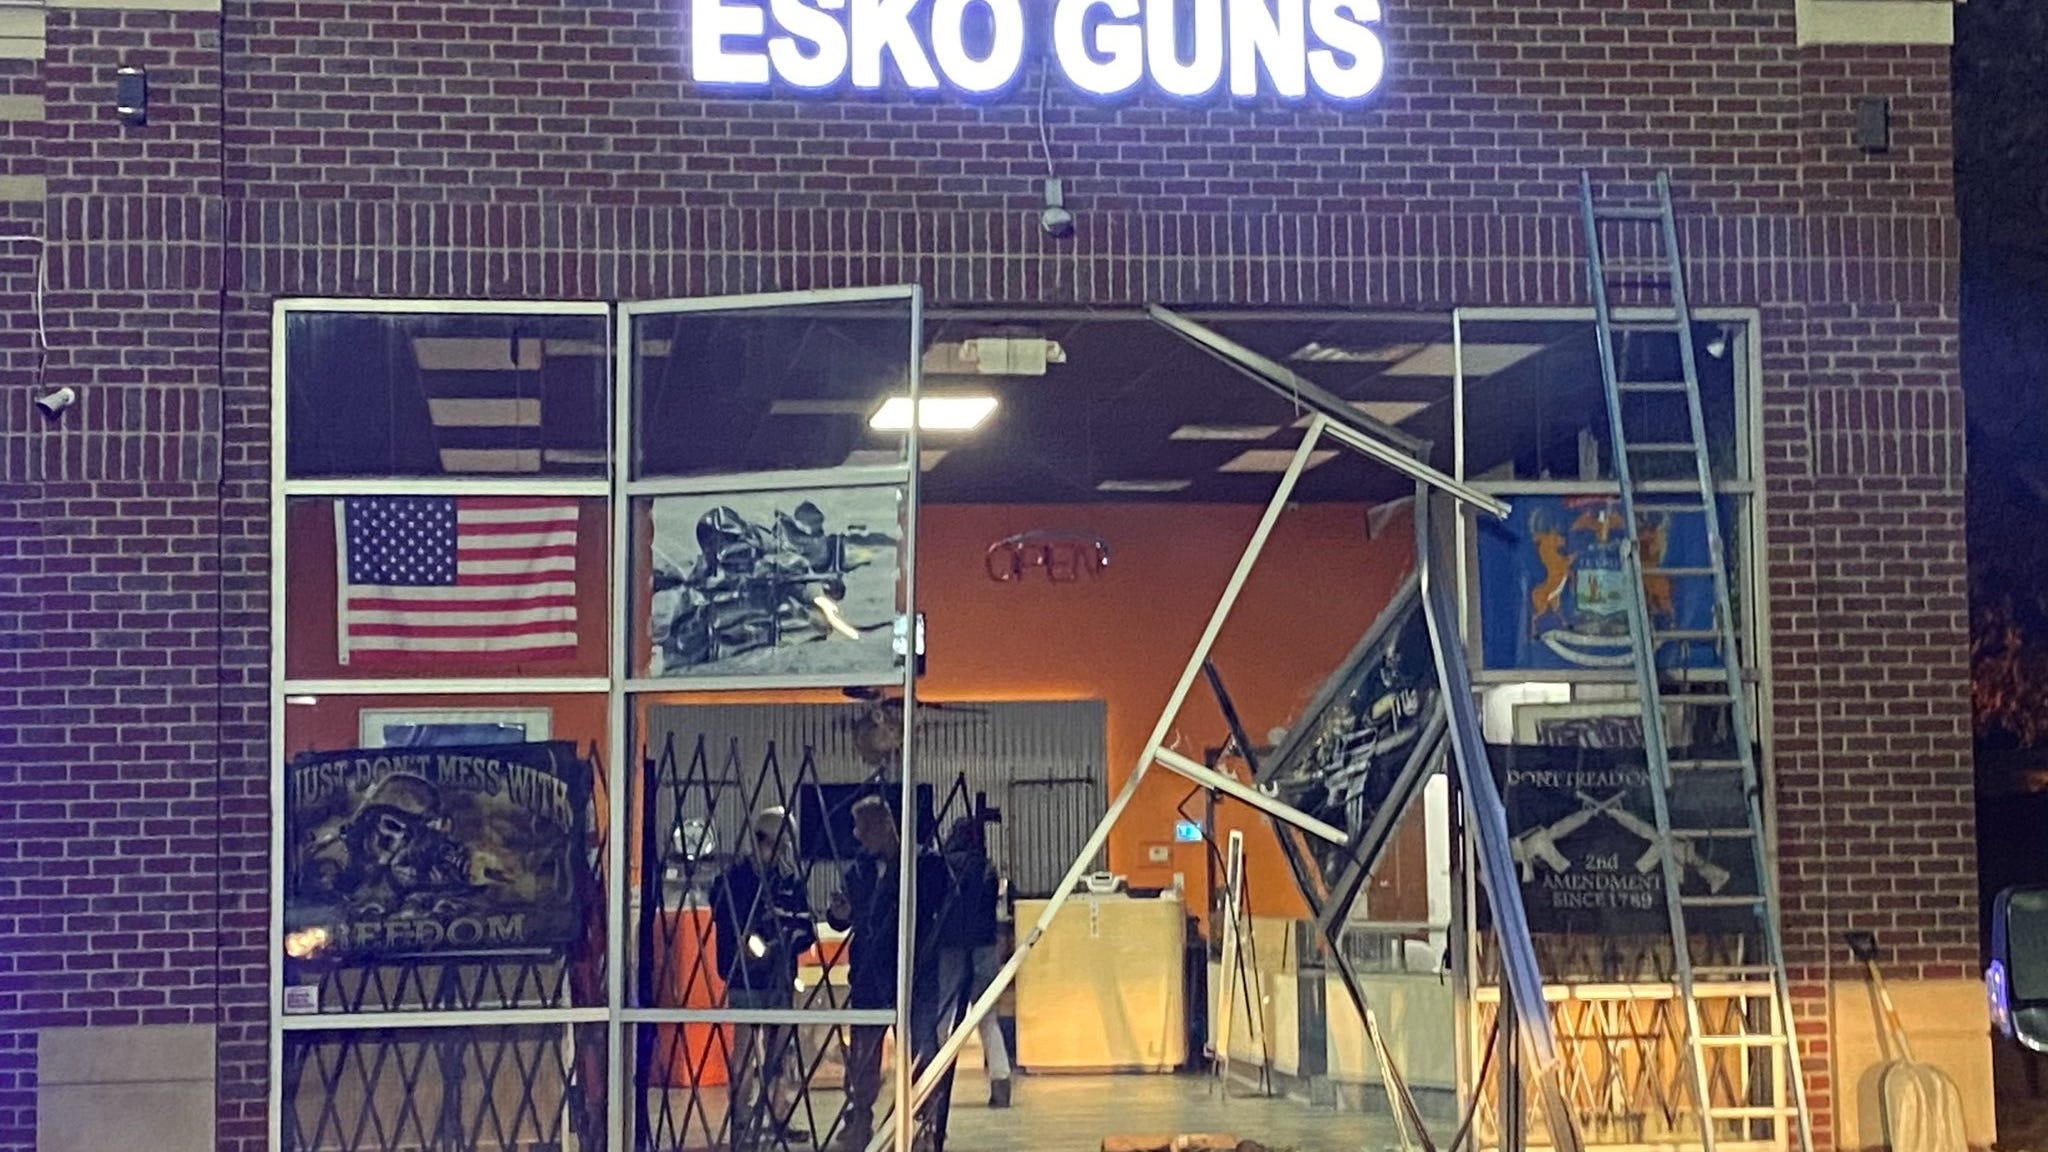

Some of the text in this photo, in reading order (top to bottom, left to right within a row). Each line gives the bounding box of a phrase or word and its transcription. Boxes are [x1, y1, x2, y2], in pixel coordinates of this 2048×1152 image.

[692, 0, 1385, 99] ESKO GUNS
[985, 540, 1106, 583] OPEN
[294, 754, 574, 834] JUST DON'T MESS WITH
[1584, 852, 1619, 872] 2nd
[1543, 873, 1662, 891] AMENDMENT
[1552, 891, 1604, 909] SINCE
[318, 914, 525, 948] REEDOM
